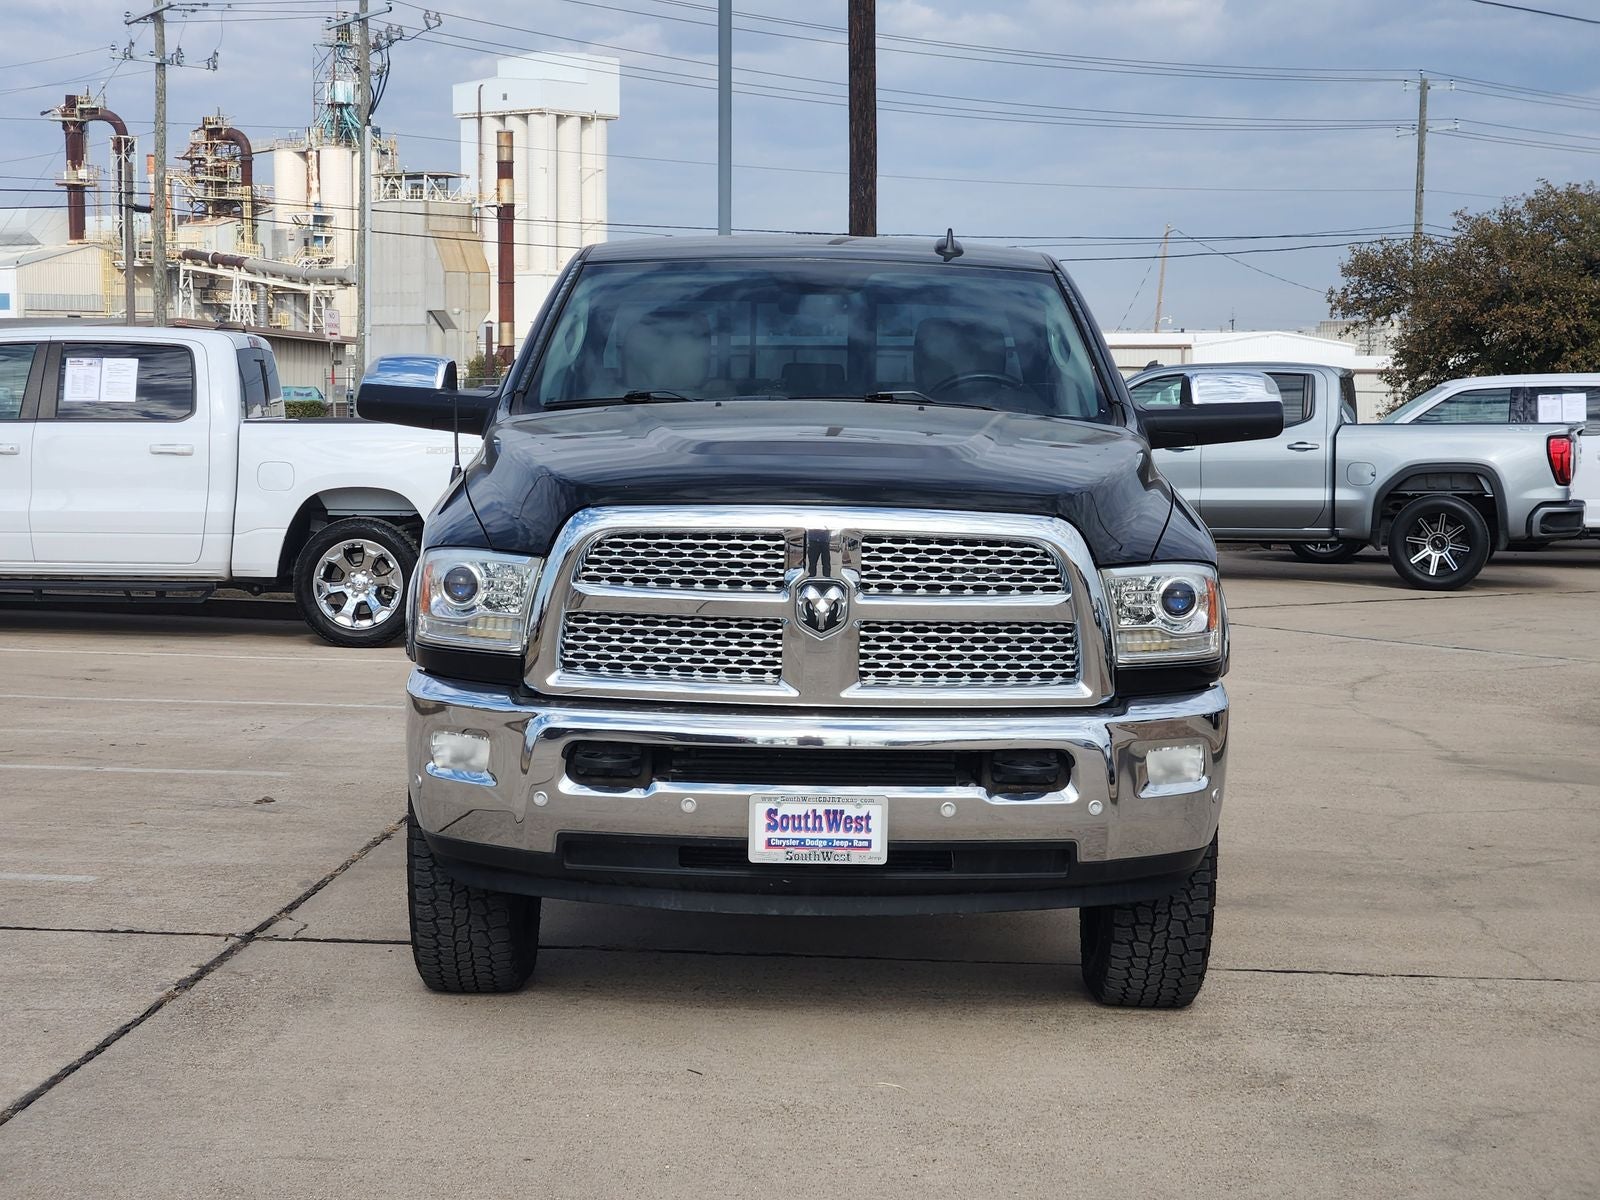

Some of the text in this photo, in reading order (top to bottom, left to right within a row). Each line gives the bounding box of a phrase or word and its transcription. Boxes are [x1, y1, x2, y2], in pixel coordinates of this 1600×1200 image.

[765, 807, 872, 834] SouthWest
[770, 838, 800, 847] Chrysler
[805, 839, 827, 848] Dodge
[832, 840, 849, 848] Jeep
[785, 850, 851, 862] SouthWest
